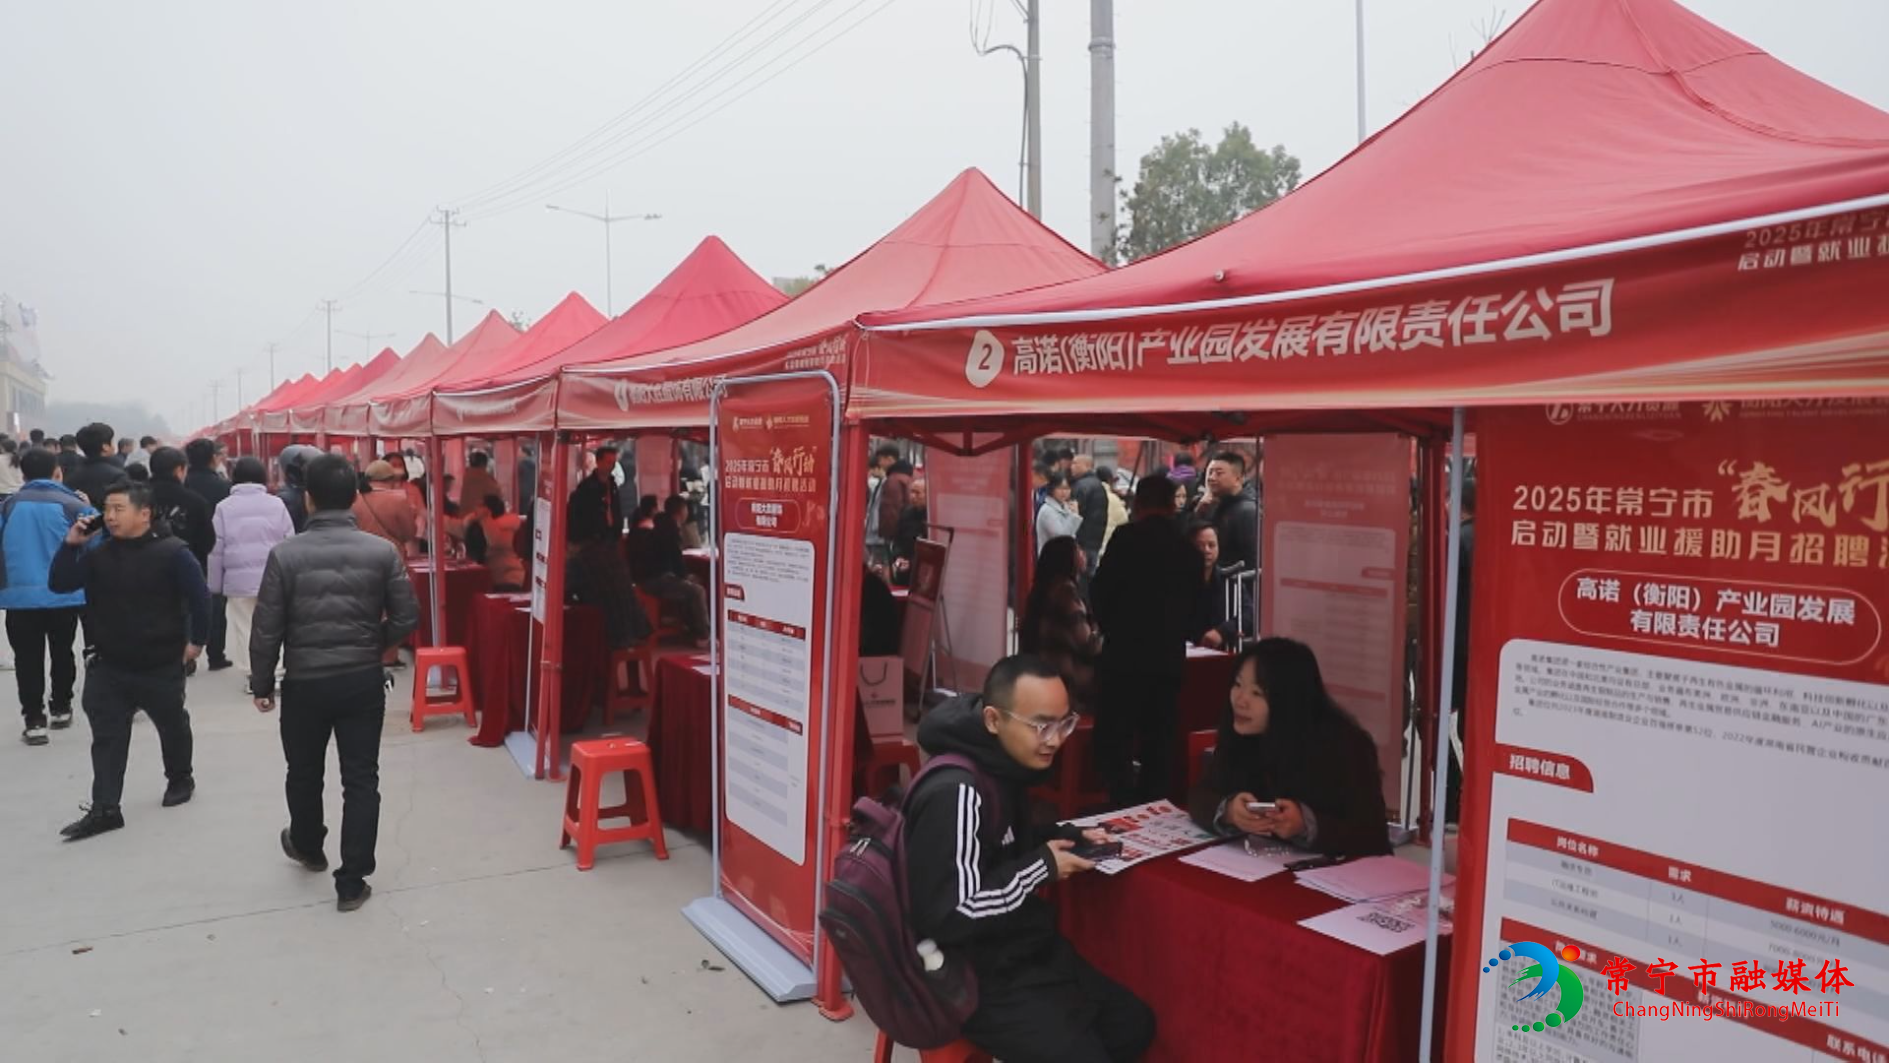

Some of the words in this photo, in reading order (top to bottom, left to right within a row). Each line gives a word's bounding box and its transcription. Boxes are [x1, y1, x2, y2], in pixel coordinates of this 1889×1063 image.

[1513, 486, 1714, 520] 2025年常宁市
[1630, 608, 1780, 647] 有限责任公司
[1509, 754, 1571, 780] 招聘信息
[1556, 836, 1599, 857] 岗位名称
[1668, 867, 1692, 882] 需求
